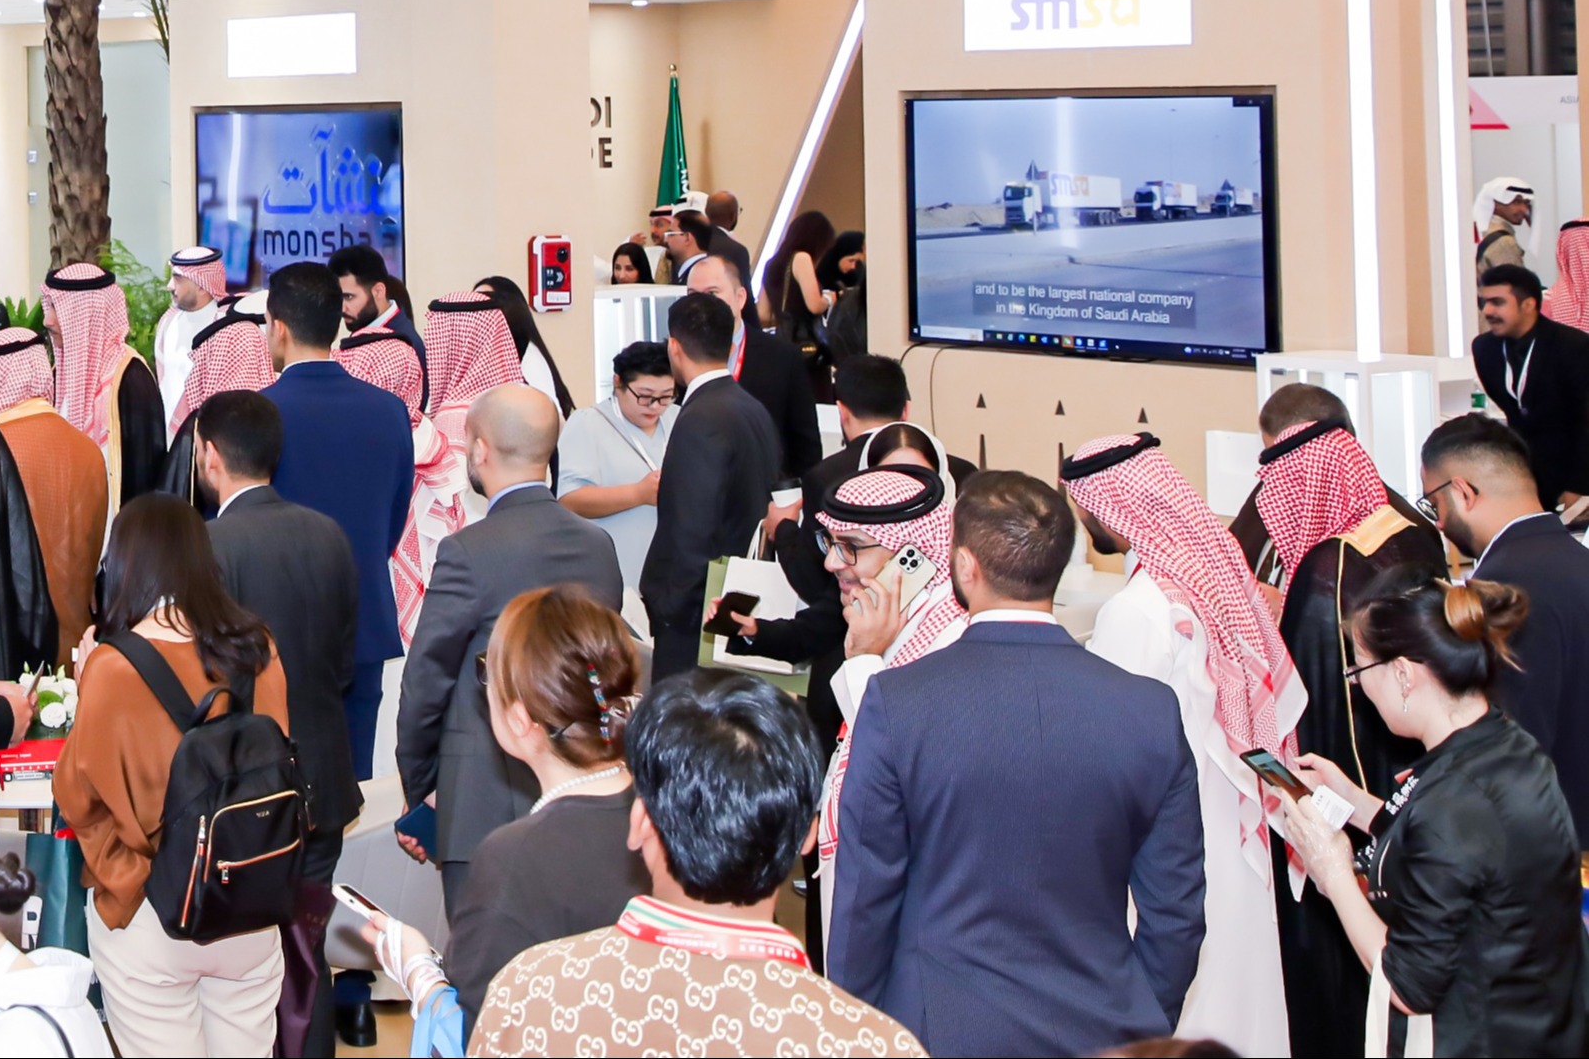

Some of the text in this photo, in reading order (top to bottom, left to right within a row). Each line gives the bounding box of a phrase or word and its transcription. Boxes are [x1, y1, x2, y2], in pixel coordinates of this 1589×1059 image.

[974, 283, 1193, 309] and to be the largest national company
[996, 301, 1170, 324] in the Kingdom of Saudi Arabia
